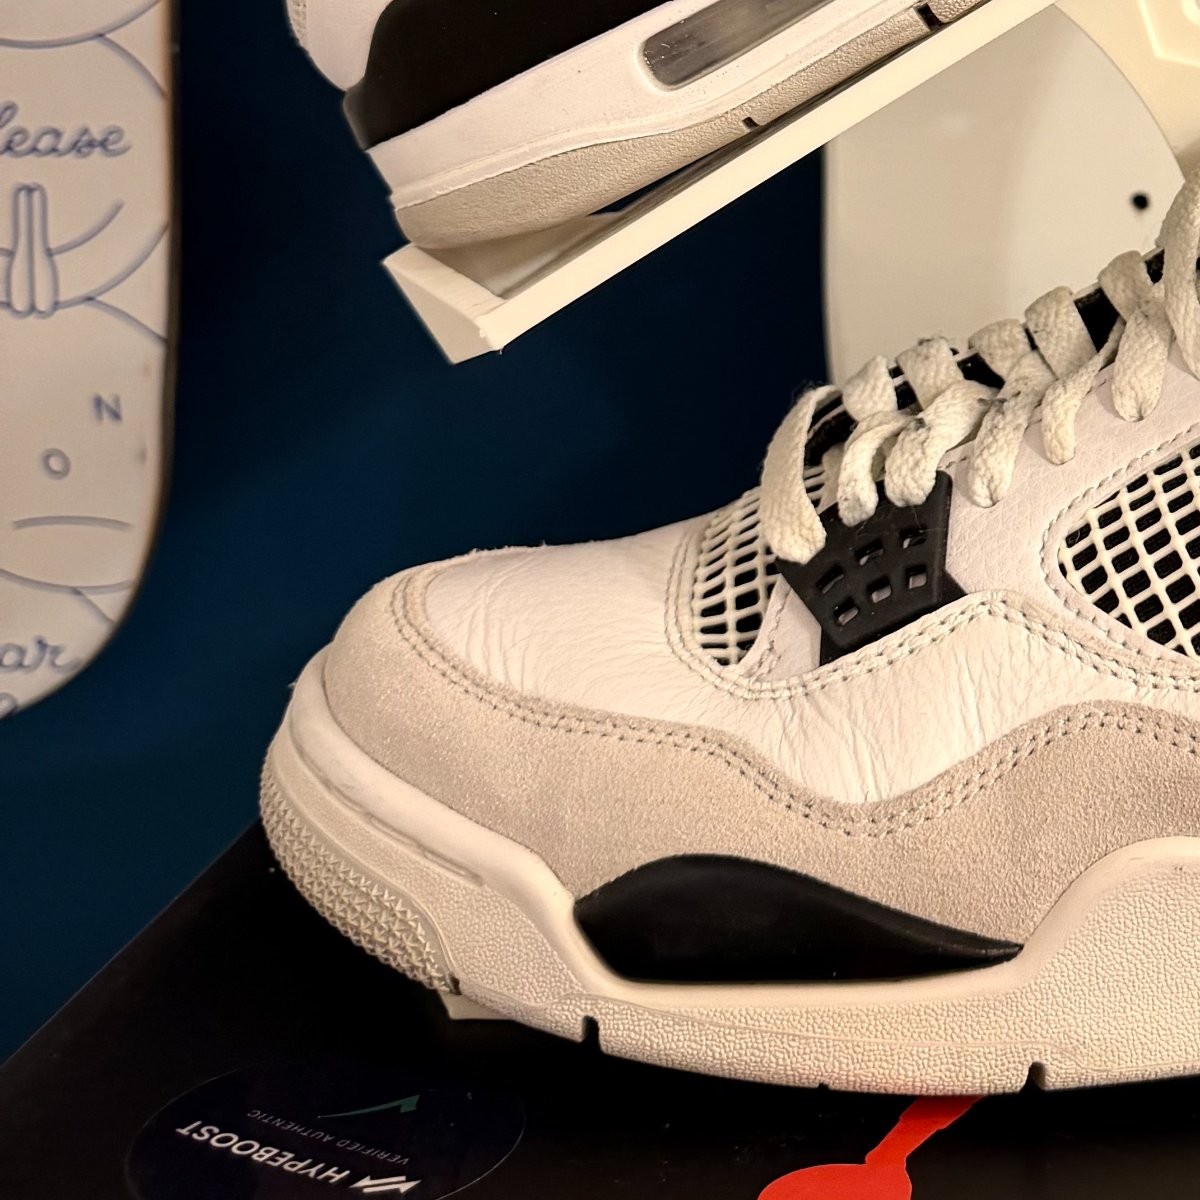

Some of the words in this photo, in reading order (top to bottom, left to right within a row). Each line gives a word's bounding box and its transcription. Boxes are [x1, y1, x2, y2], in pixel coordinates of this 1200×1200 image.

[246, 1109, 336, 1144] AUTHENTIC
[174, 1120, 351, 1186] HYPEBOOST
[335, 1137, 410, 1167] VERIFIED
